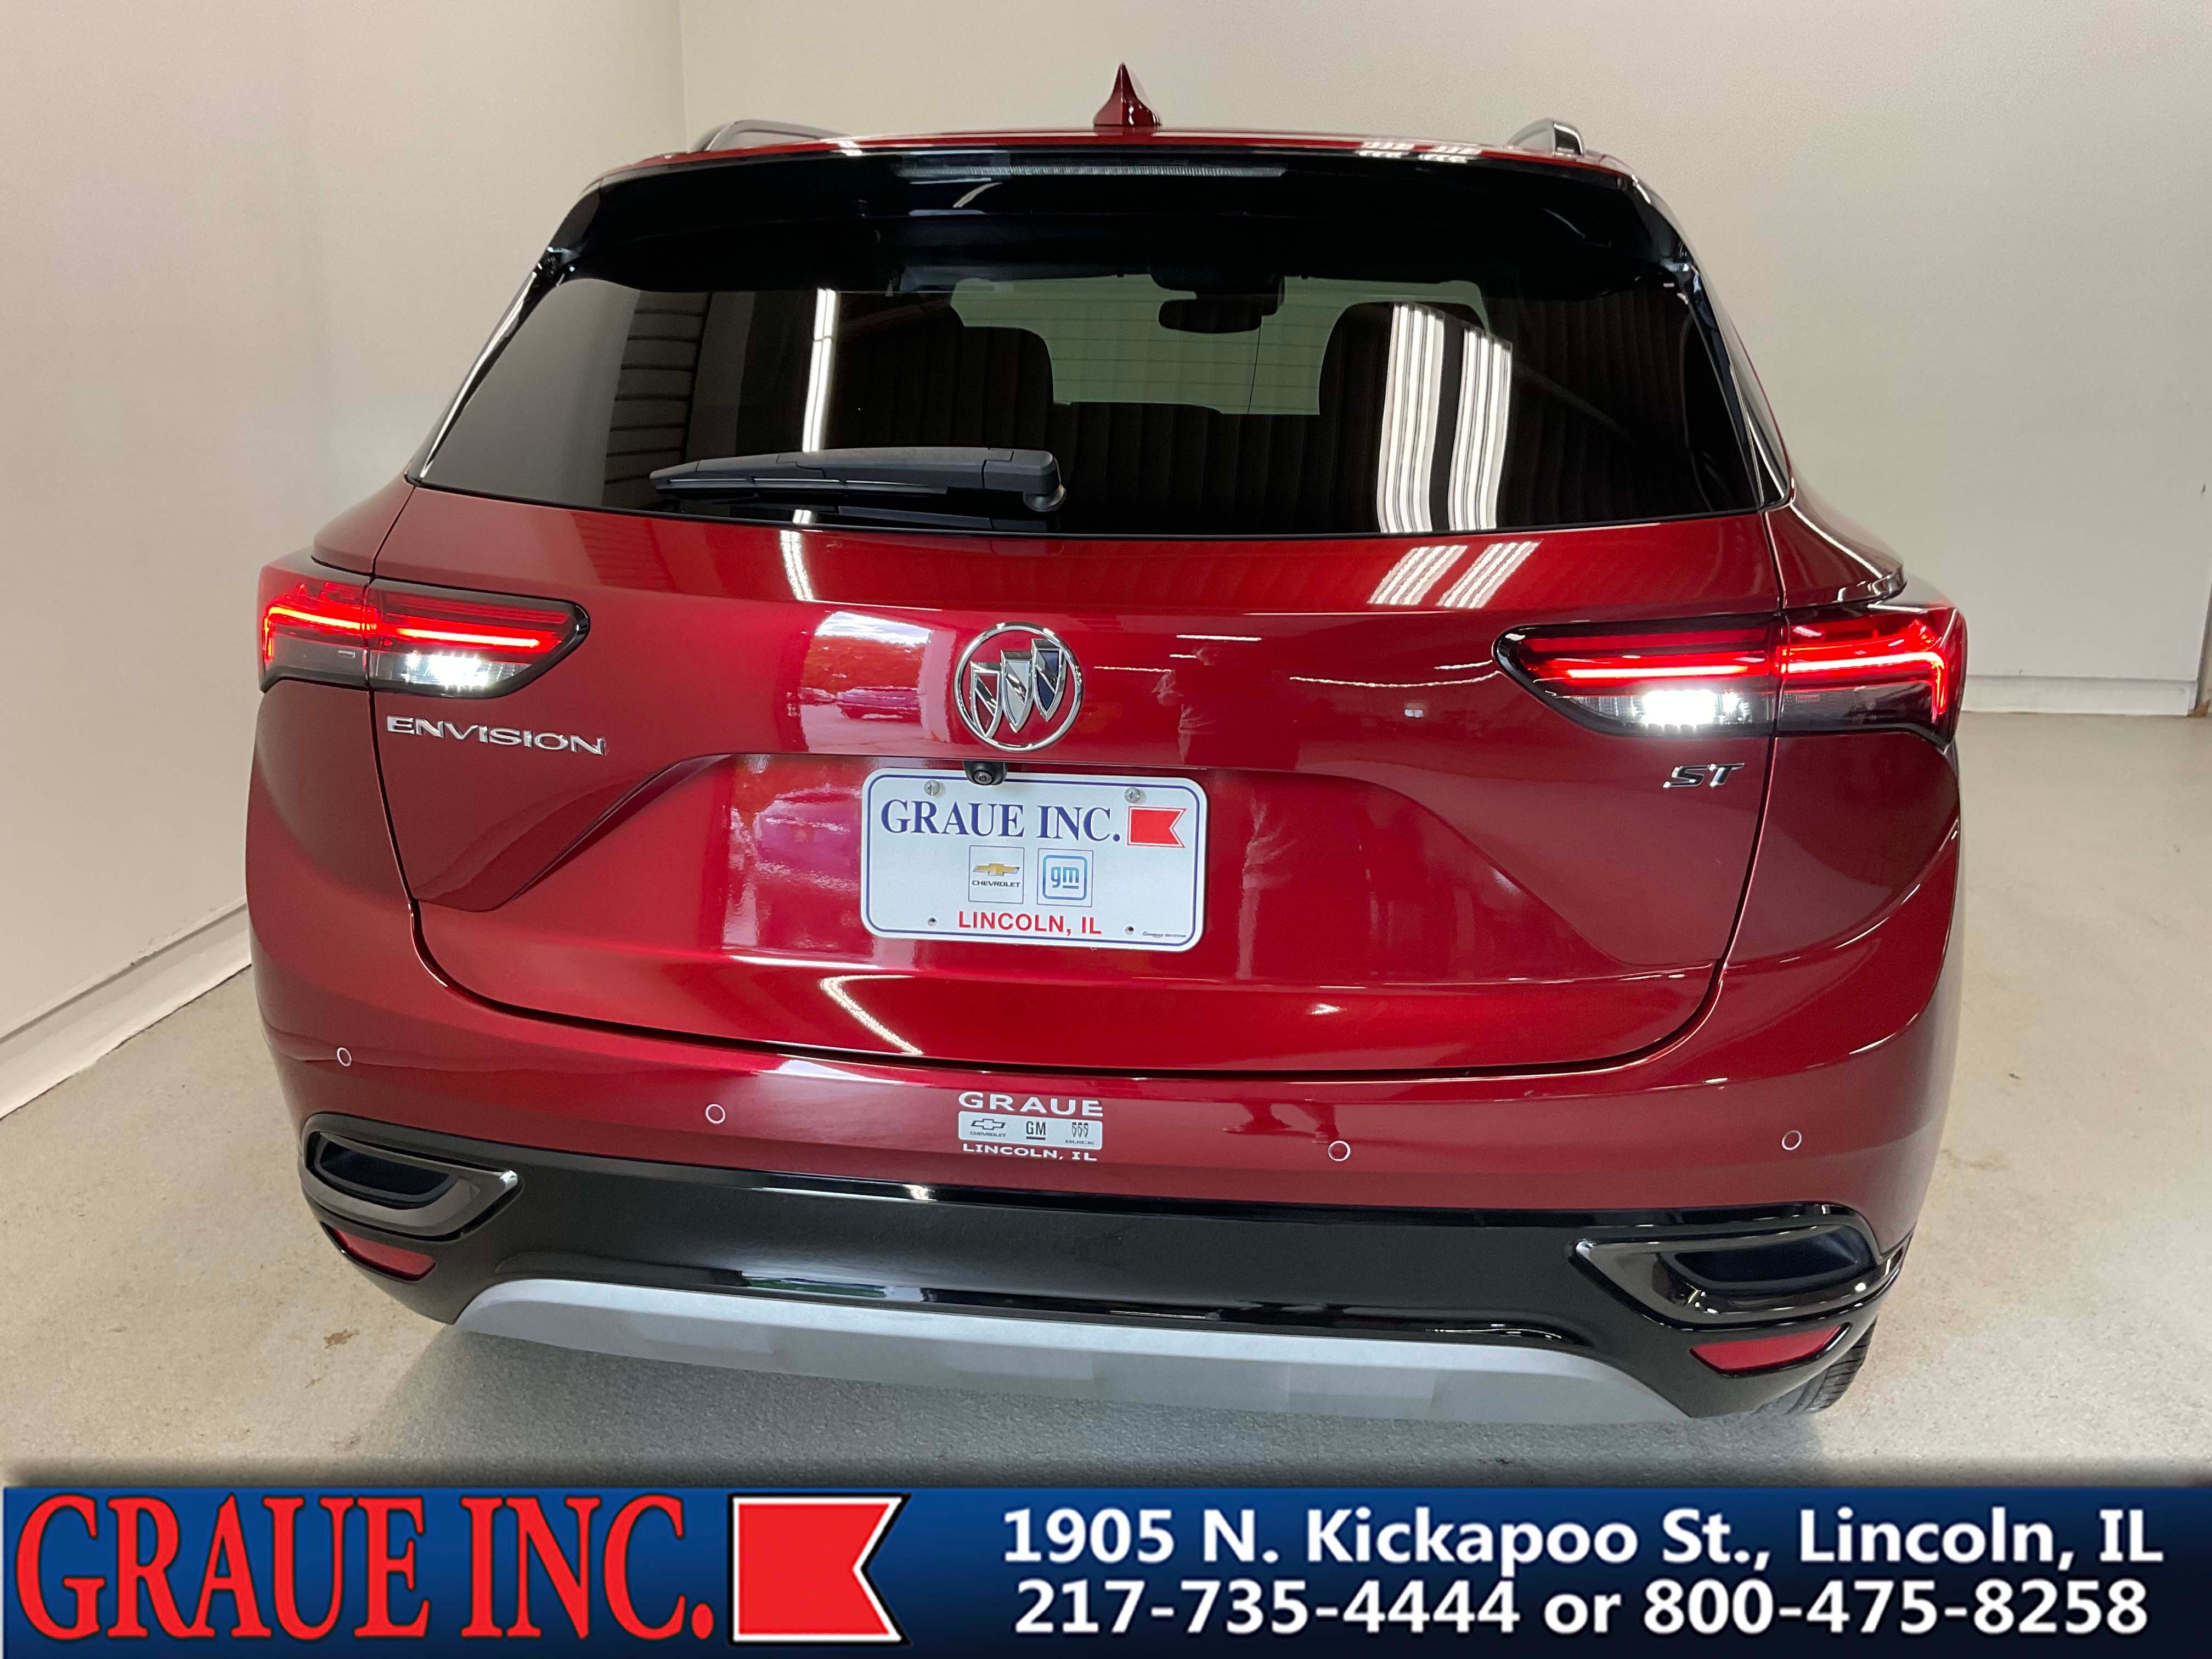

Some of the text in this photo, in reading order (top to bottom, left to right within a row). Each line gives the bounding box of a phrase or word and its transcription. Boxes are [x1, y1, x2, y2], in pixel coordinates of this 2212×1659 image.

[386, 715, 607, 755] ENVISION
[1663, 762, 1745, 788] ST
[881, 799, 1120, 842] GRAUE INC.
[972, 879, 1020, 888] CHEVROLET
[1050, 866, 1080, 889] gm
[958, 911, 1102, 935] LINCOLN, IL
[958, 1091, 1103, 1117] GRAUE
[1025, 1120, 1046, 1136] GM
[963, 1143, 1097, 1161] LINCOLN, IL
